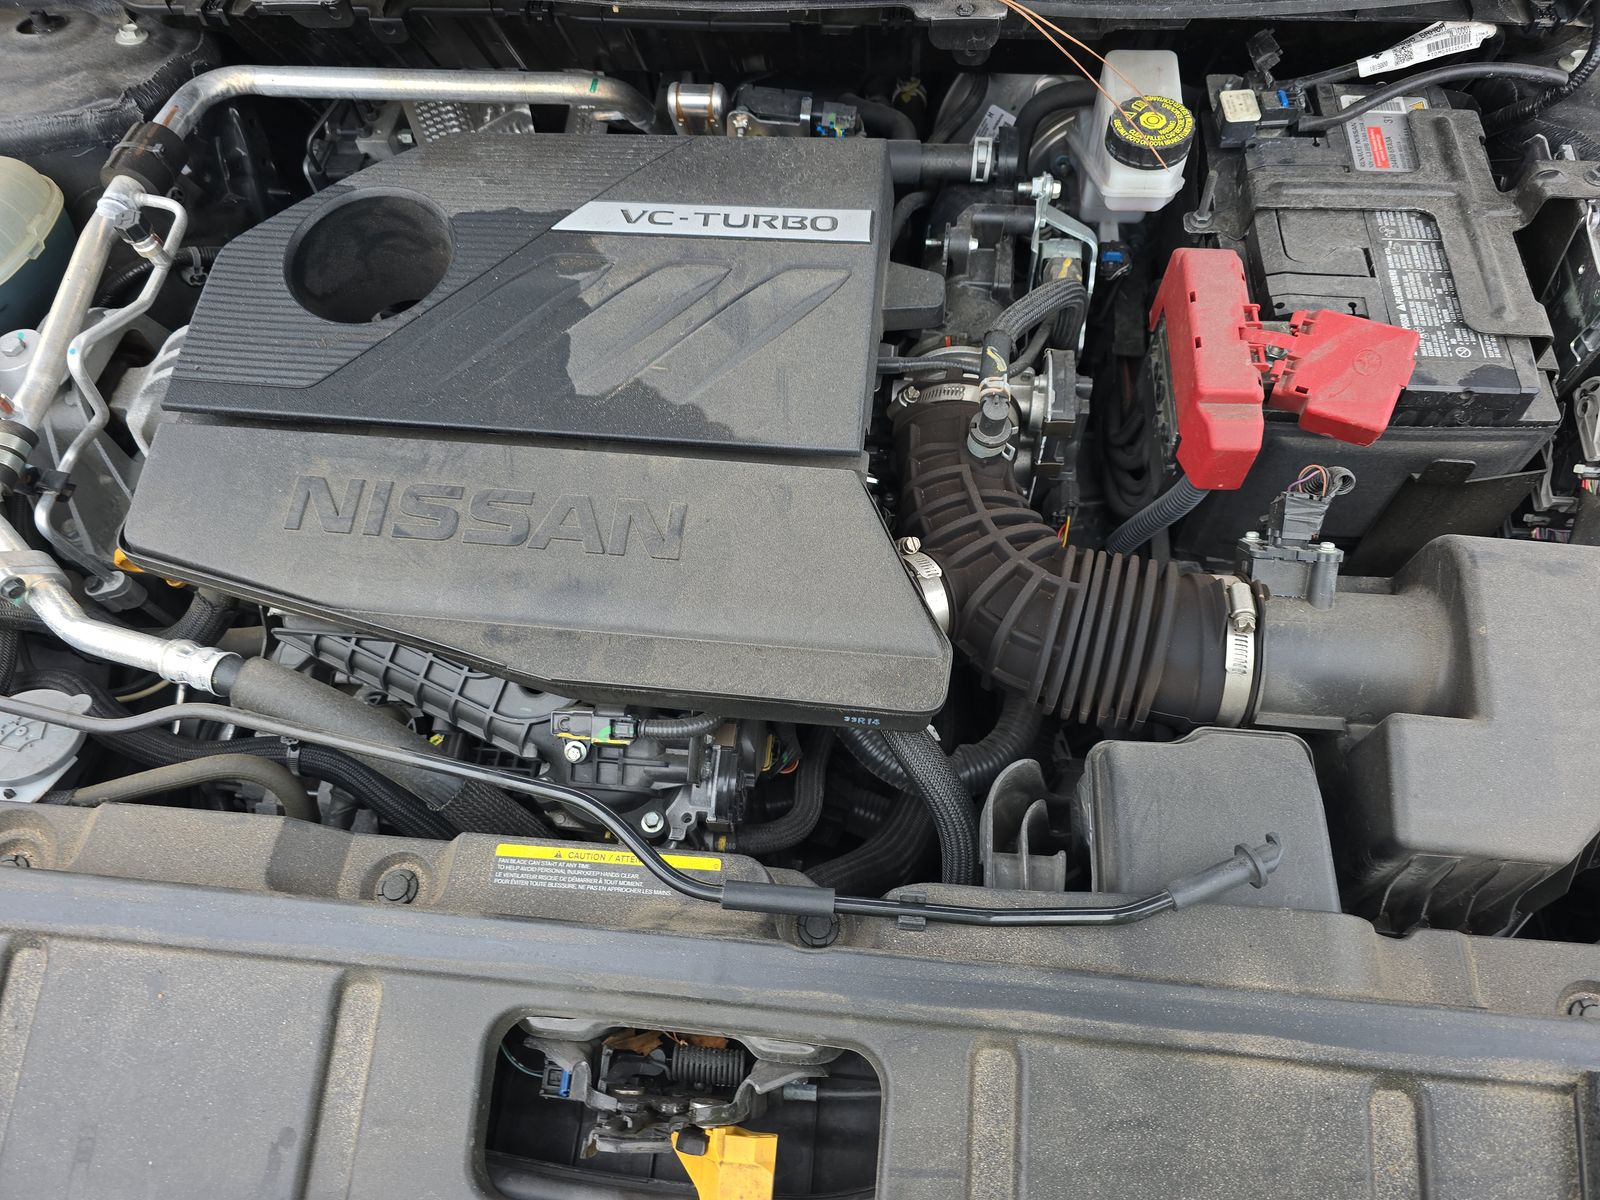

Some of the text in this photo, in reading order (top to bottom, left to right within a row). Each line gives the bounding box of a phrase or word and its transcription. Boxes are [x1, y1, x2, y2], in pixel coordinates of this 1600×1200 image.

[1352, 122, 1361, 144] NISSAN
[621, 208, 838, 232] VC-TURBO
[283, 474, 688, 560] NISSAN
[568, 852, 605, 861] CAUTION
